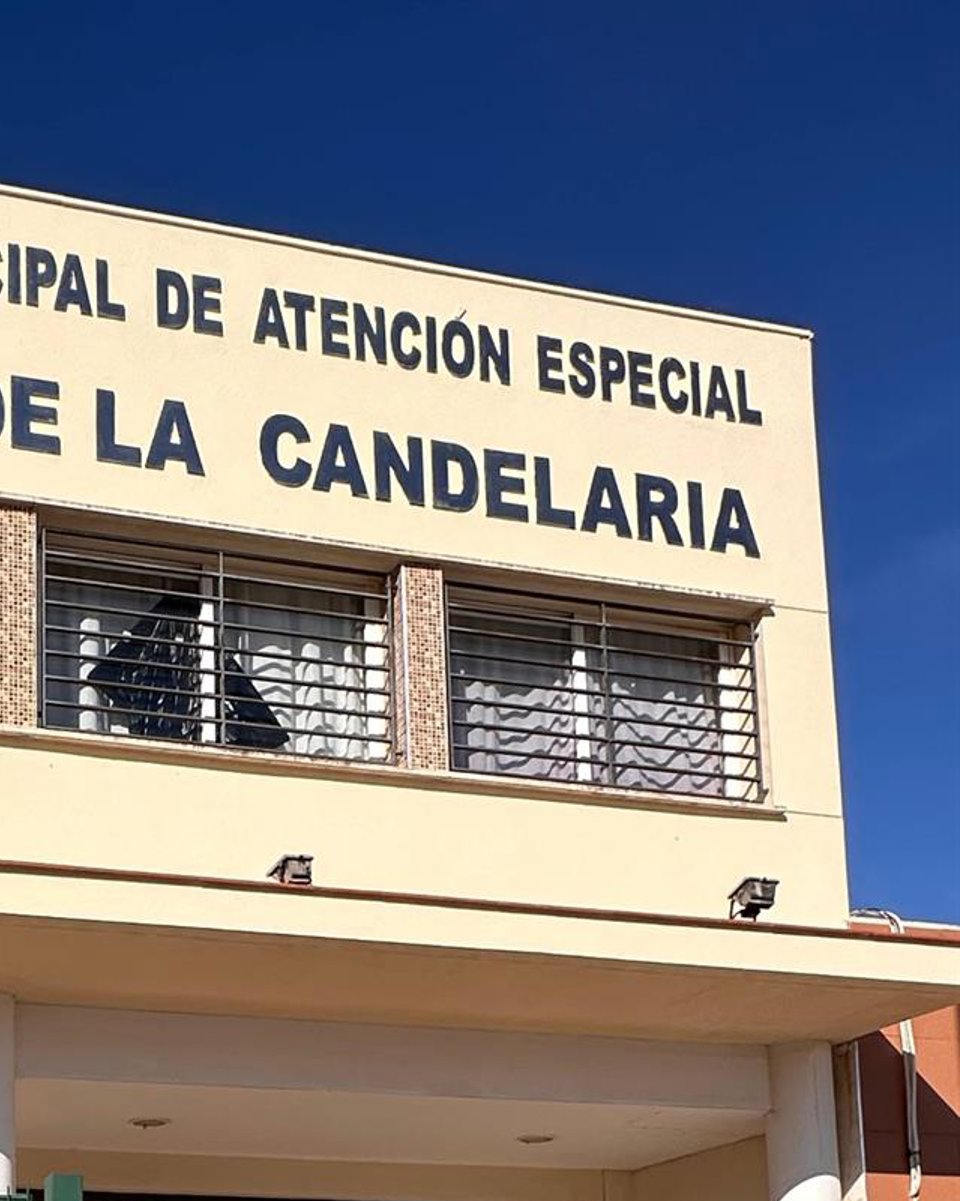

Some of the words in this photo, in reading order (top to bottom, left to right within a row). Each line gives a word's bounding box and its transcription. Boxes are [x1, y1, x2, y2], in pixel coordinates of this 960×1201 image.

[157, 268, 223, 337] DE
[254, 288, 510, 386] ATENCIÓN
[537, 335, 762, 426] ESPECIAL
[96, 389, 205, 477] LA
[260, 414, 760, 558] CANDELARIA
